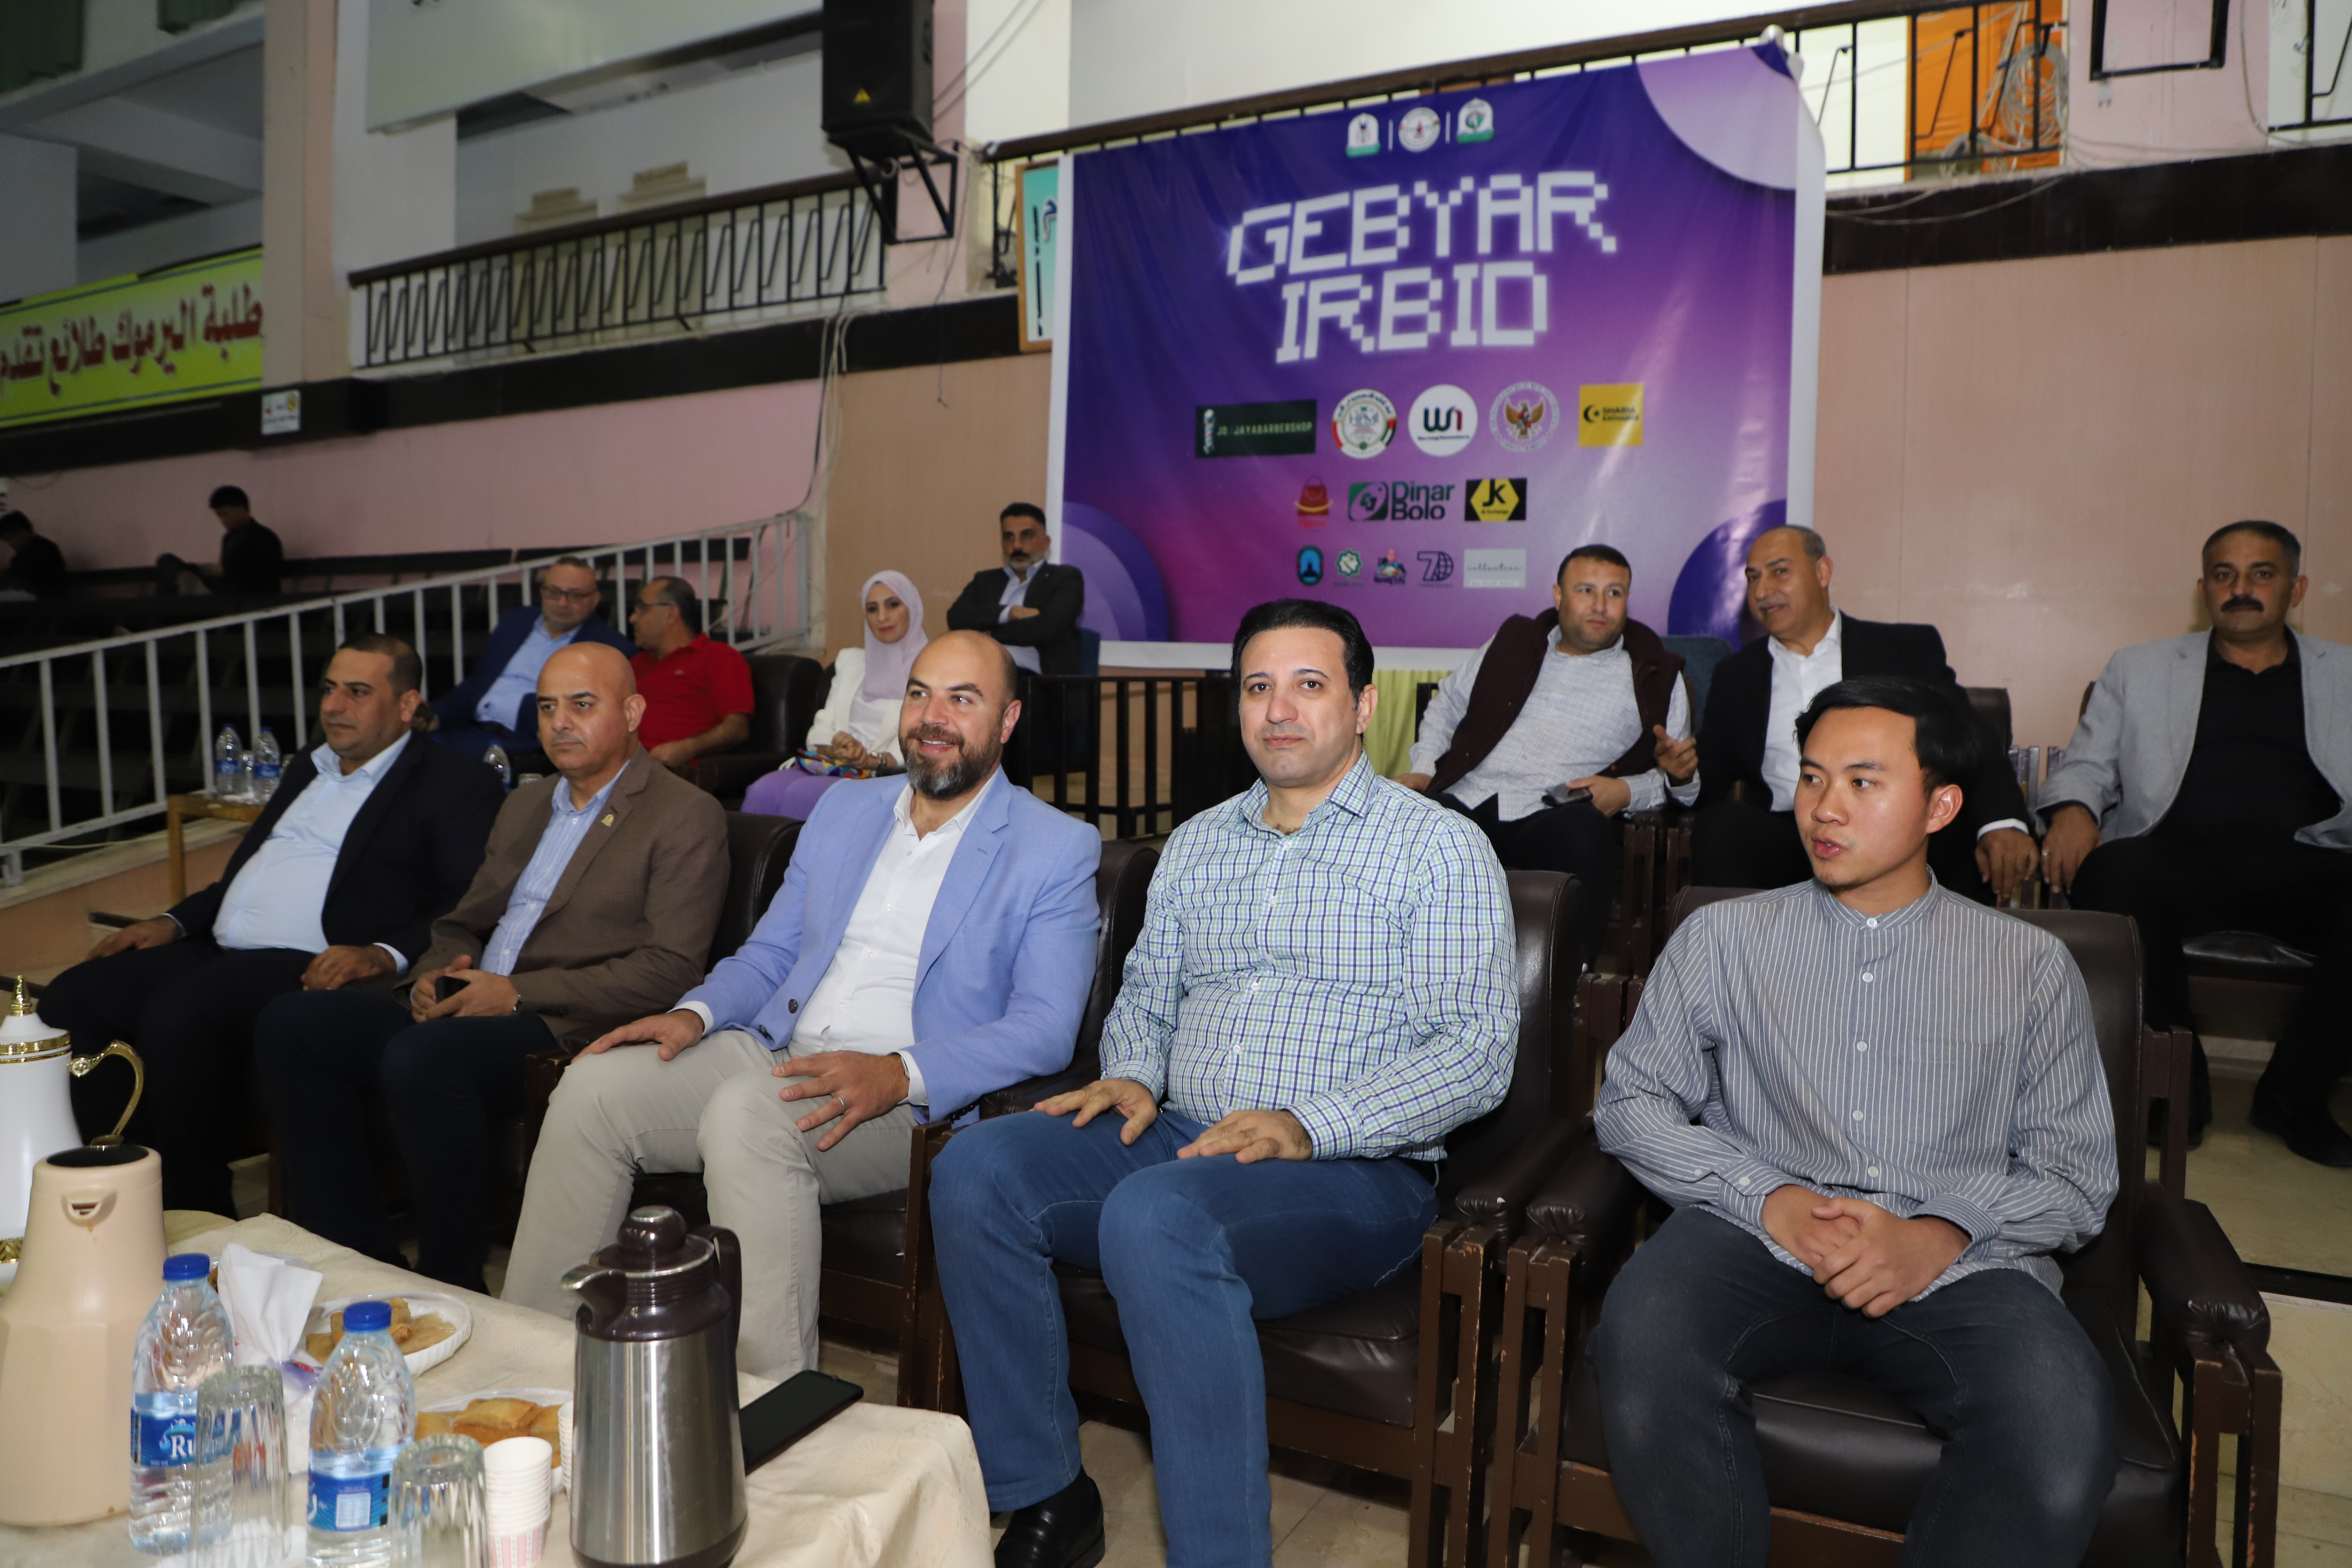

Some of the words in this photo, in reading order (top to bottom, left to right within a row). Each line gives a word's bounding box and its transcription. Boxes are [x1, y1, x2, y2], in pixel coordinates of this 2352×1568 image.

[1227, 171, 1617, 286] GEBYAR
[112, 299, 196, 375] اليرموك
[201, 282, 262, 362] طلبة
[1276, 260, 1548, 363] IRBID
[1392, 481, 1455, 501] Dinar
[1392, 499, 1446, 521] Bolo
